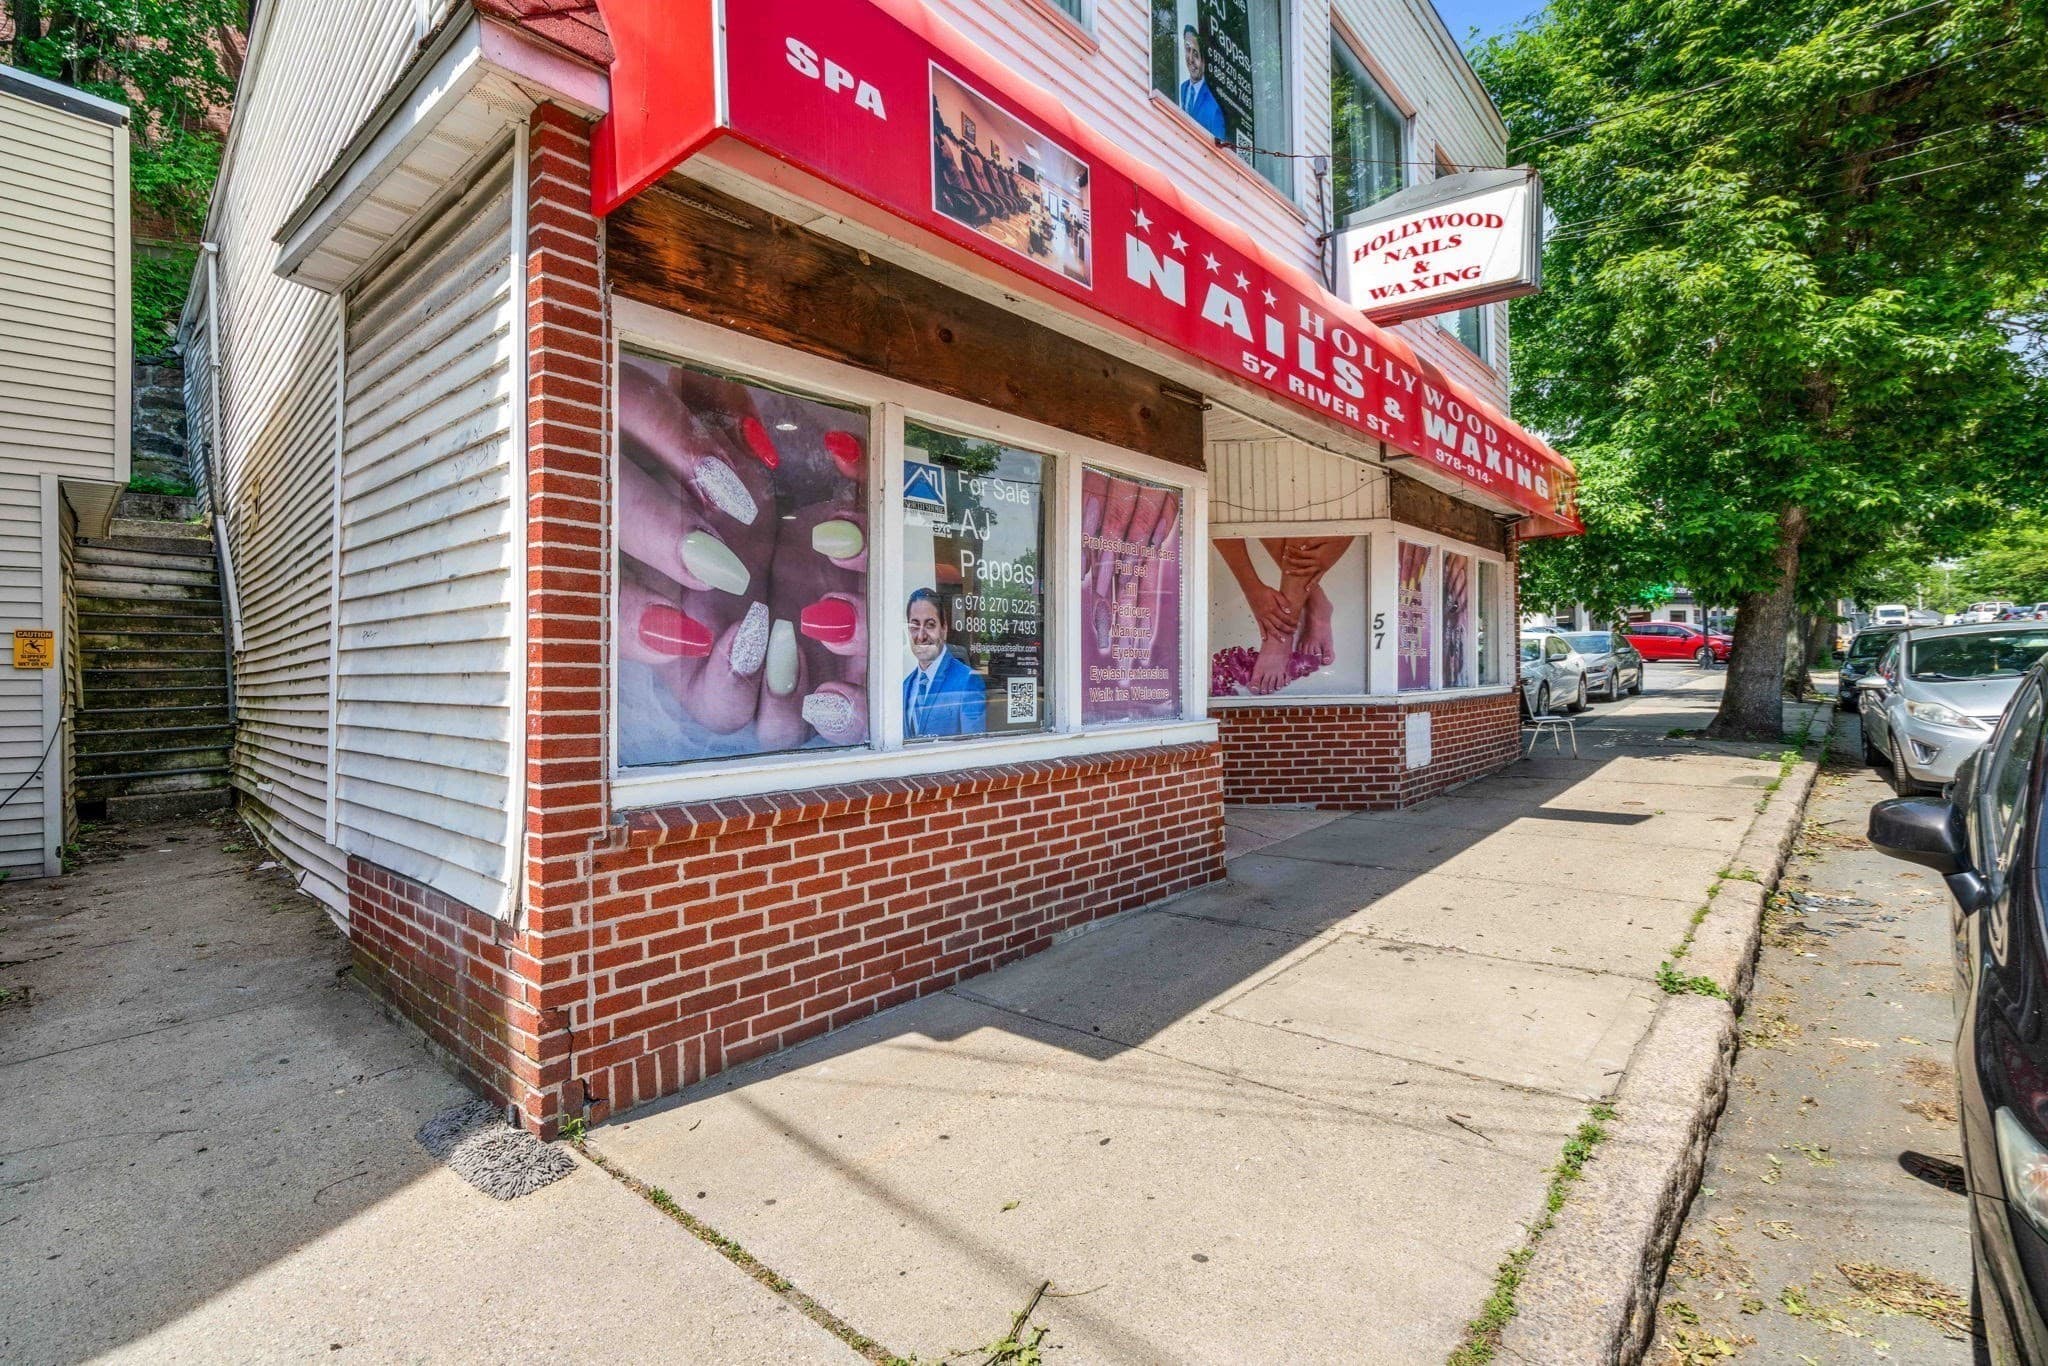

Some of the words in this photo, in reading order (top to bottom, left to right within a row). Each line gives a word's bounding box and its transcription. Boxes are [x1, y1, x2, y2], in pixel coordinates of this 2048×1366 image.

[1210, 15, 1250, 71] Pappas
[785, 37, 887, 120] SPA
[1353, 213, 1503, 264] HOLLYWOOD
[1383, 234, 1462, 264] NAILS
[1369, 265, 1482, 300] WAXING
[1413, 260, 1430, 274] &
[1126, 232, 1365, 399] NAILS
[1384, 397, 1406, 422] &
[1421, 406, 1549, 500] WAXING
[1298, 303, 1498, 444] HOLLYWOOD
[1242, 351, 1278, 381] 57
[1288, 374, 1360, 421] RIVER
[1366, 413, 1394, 439] ST.
[1436, 448, 1494, 484] 978-914-
[957, 469, 988, 496] For
[993, 478, 1030, 505] Sale
[960, 508, 990, 541] AJ
[1082, 533, 1140, 556] Professional
[1141, 545, 1156, 558] nail
[1158, 549, 1175, 560] care
[960, 549, 1035, 588] Pappas
[1115, 560, 1133, 575] Full
[1134, 565, 1148, 578] set
[965, 595, 986, 611] 978
[989, 597, 1009, 613] 270
[1011, 600, 1037, 615] 5225
[1112, 601, 1150, 617] Pedicure
[966, 617, 987, 633] 888
[989, 618, 1010, 634] 854
[1012, 620, 1037, 635] 7493
[1111, 624, 1151, 638] Manicure
[1112, 644, 1151, 661] Eyebrow
[1090, 665, 1127, 683] Eyelash
[1128, 666, 1169, 680] extension
[1089, 687, 1113, 702] Walk
[1115, 687, 1129, 700] ins
[1131, 686, 1169, 700] Welcome
